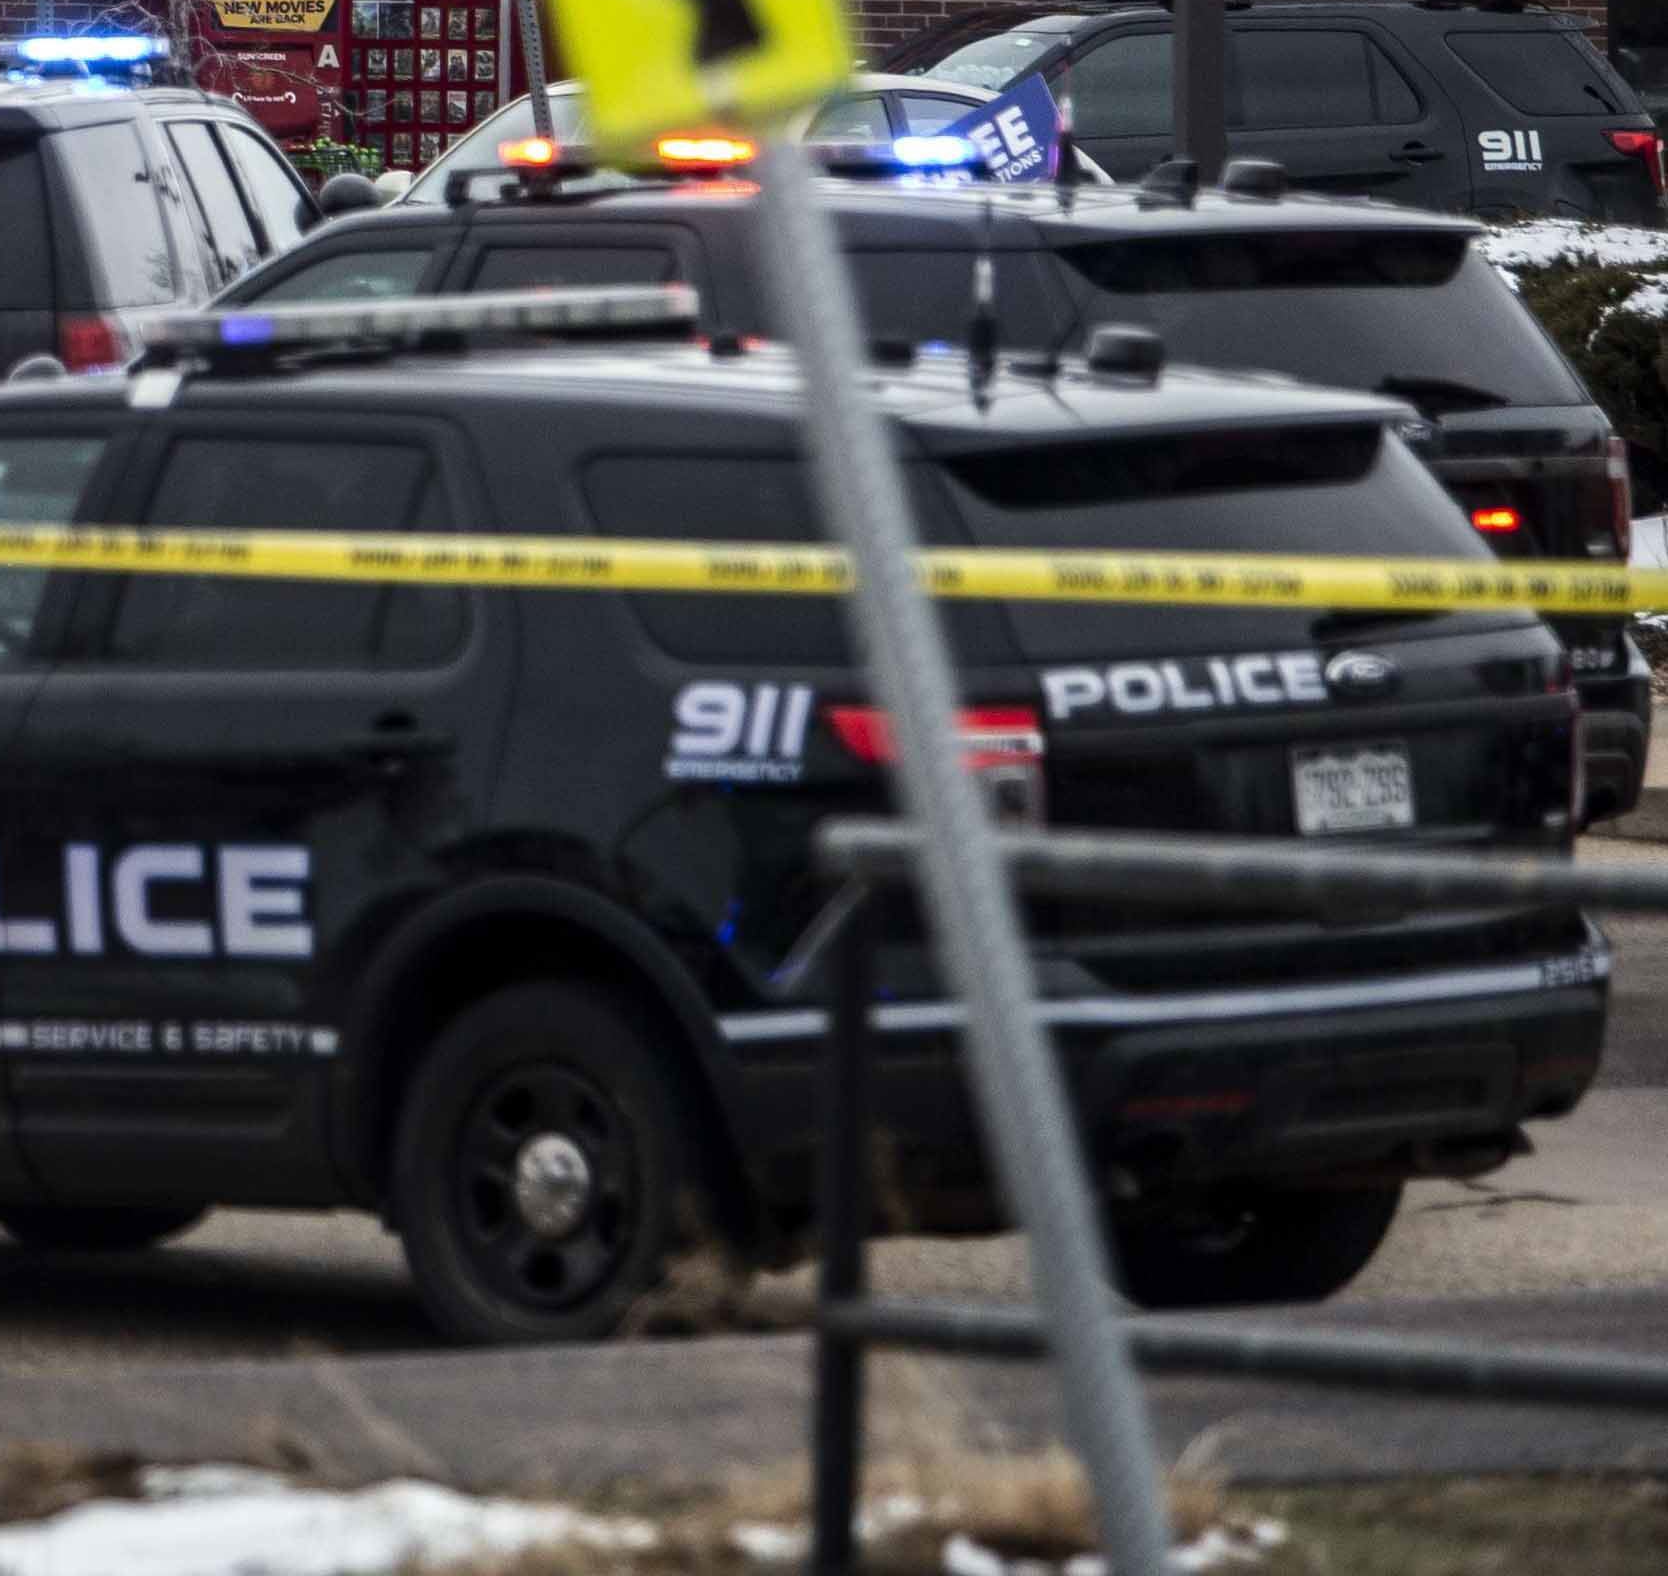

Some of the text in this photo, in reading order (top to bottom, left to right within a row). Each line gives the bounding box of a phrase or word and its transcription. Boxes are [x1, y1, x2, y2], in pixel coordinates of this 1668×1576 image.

[224, 0, 325, 14] NEW MOVIES
[317, 44, 340, 68] A
[1478, 130, 1542, 161] 911
[1040, 650, 1329, 720] POLICE
[672, 682, 814, 758] 911
[30, 1025, 152, 1050] SERVICE
[194, 1027, 307, 1052] SAFETY
